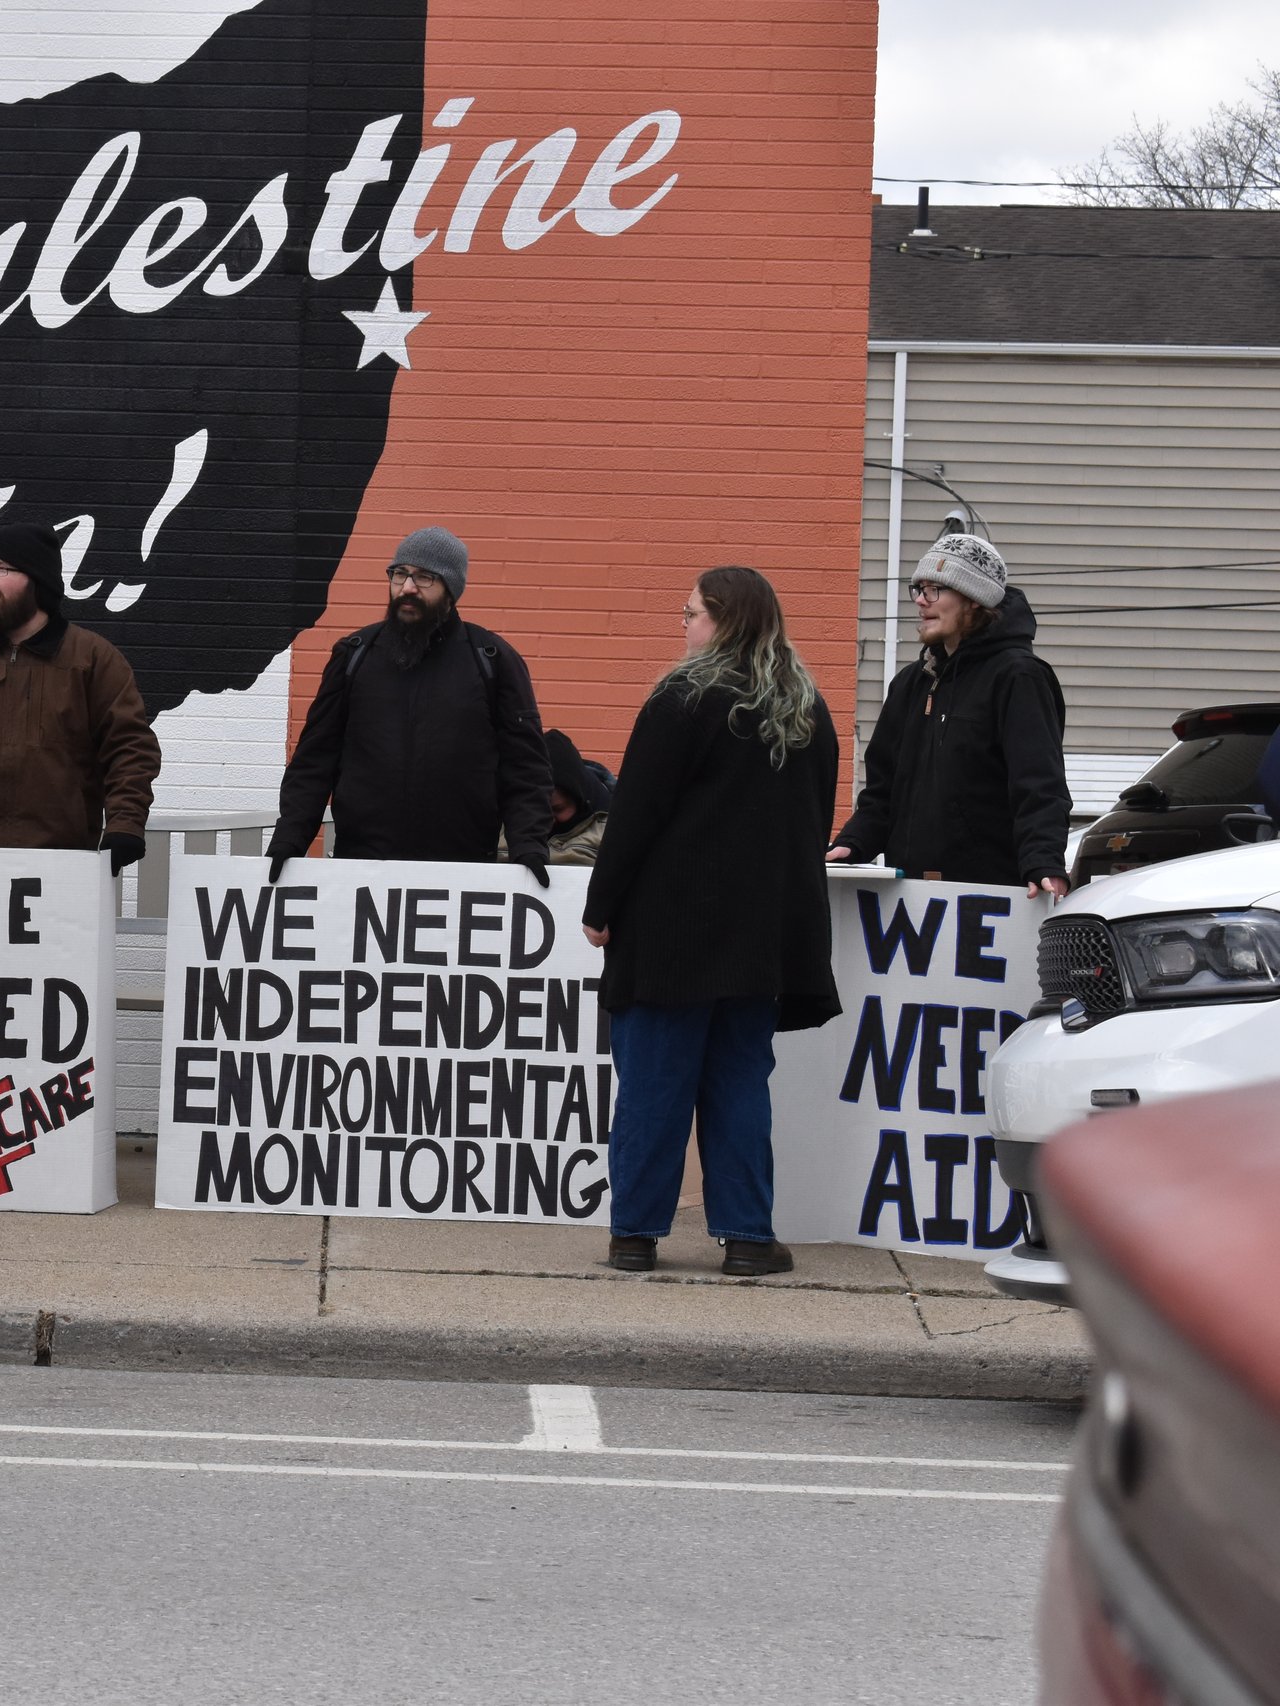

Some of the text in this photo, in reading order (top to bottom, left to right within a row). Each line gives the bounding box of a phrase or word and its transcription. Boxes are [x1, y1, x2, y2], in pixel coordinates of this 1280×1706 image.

[195, 886, 556, 970] WE NEED
[857, 889, 1011, 983] WE
[195, 1131, 610, 1219] MONITORING
